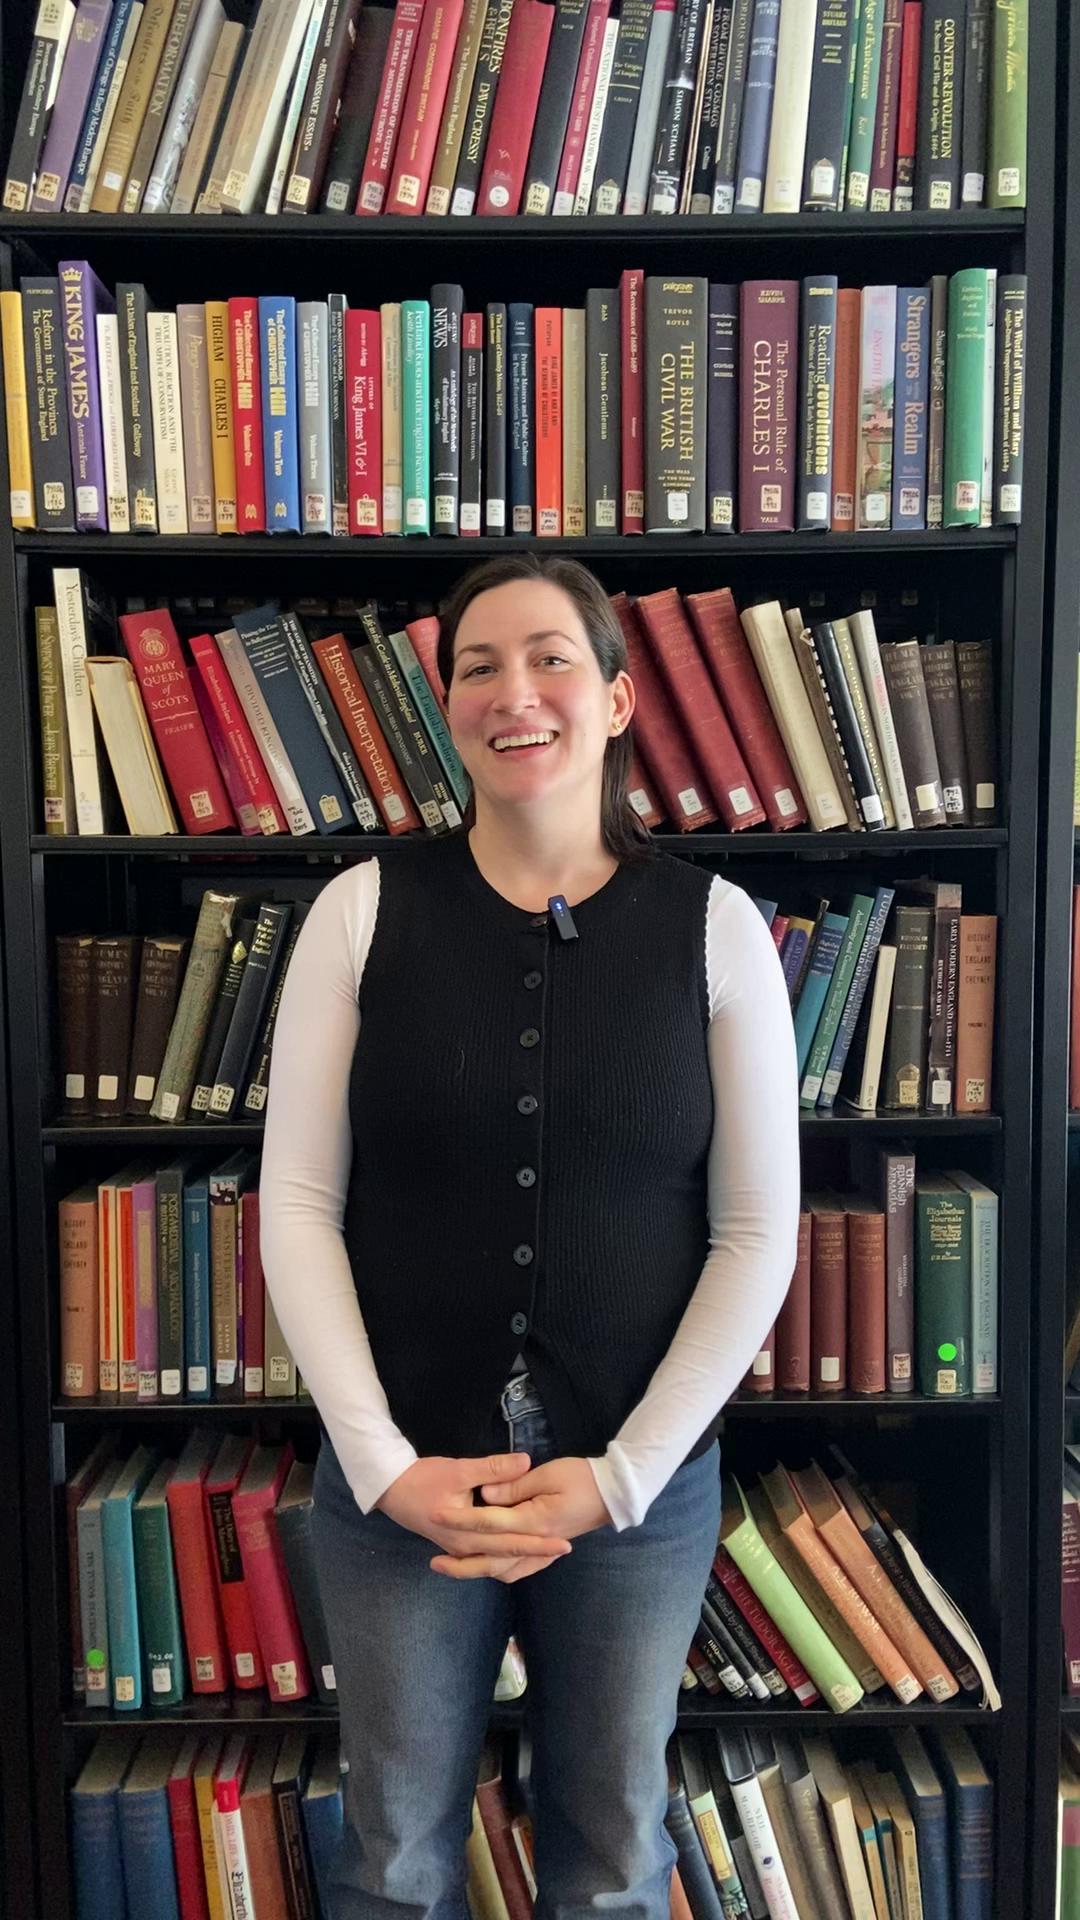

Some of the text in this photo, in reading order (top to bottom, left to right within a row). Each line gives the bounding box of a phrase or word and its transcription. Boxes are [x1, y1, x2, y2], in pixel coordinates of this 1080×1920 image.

[389, 40, 401, 66] EARLY
[489, 0, 514, 74] BONFIRES
[684, 27, 696, 64] BRITAIN
[152, 13, 188, 116] REFORMATION
[710, 8, 732, 128] FROM DIVINE COSMOS
[860, 38, 875, 99] Exuberance
[304, 63, 327, 147] RENAISSANCE ESSAYS
[380, 29, 414, 170] THE TRANSMISSION OF CULTURE
[382, 69, 396, 106] MODERN
[941, 19, 955, 158] COUNTER-REVOLUTION
[84, 116, 100, 146] Modern
[376, 109, 388, 142] EUROPE
[467, 83, 490, 164] DAVID CRESSY
[668, 90, 684, 162] SIMON SCHAMA
[78, 148, 92, 175] Europe
[127, 292, 135, 306] The
[630, 277, 638, 290] The
[127, 308, 136, 330] Union
[267, 319, 276, 327] of
[276, 310, 285, 325] The
[414, 311, 425, 350] Fenland
[434, 308, 447, 348] NEWS
[128, 339, 138, 370] England
[212, 316, 224, 362] HIGHAM
[276, 324, 286, 359] Collected
[33, 310, 49, 441] The Government of Stuart England
[42, 310, 58, 435] Reform in the Provinces
[65, 286, 90, 479] KING JAMES Antonia Fraser
[129, 371, 138, 384] and
[352, 376, 367, 403] King
[902, 296, 926, 455] Strangers Realm
[1010, 308, 1024, 457] The World of William and Mary
[130, 386, 140, 416] Scotland
[214, 379, 228, 431] CHARLES
[599, 353, 609, 440] Jacobean Gentleman
[661, 353, 675, 450] CIVIL WAR
[679, 341, 695, 460] THE BRITISH
[752, 340, 772, 472] CHARLES I
[775, 340, 788, 473] The Personal Rule of
[132, 424, 141, 457] Galloway
[352, 406, 366, 440] James
[412, 417, 425, 455] English
[244, 425, 252, 466] Volume One
[274, 430, 284, 476] Volume Two
[356, 441, 367, 456] VI
[356, 457, 366, 469] &
[65, 583, 85, 697] Yesterday's Children
[143, 671, 184, 687] QUEEN
[144, 660, 176, 672] MARY
[152, 695, 190, 710] SCOTS
[161, 684, 171, 695] of
[326, 645, 394, 796] Historical Interpretation
[412, 731, 428, 755] BURKE
[841, 916, 876, 1027] THE WORLD OF JOHN STOW
[947, 919, 958, 1019] EARLY MODERN ENGLAND
